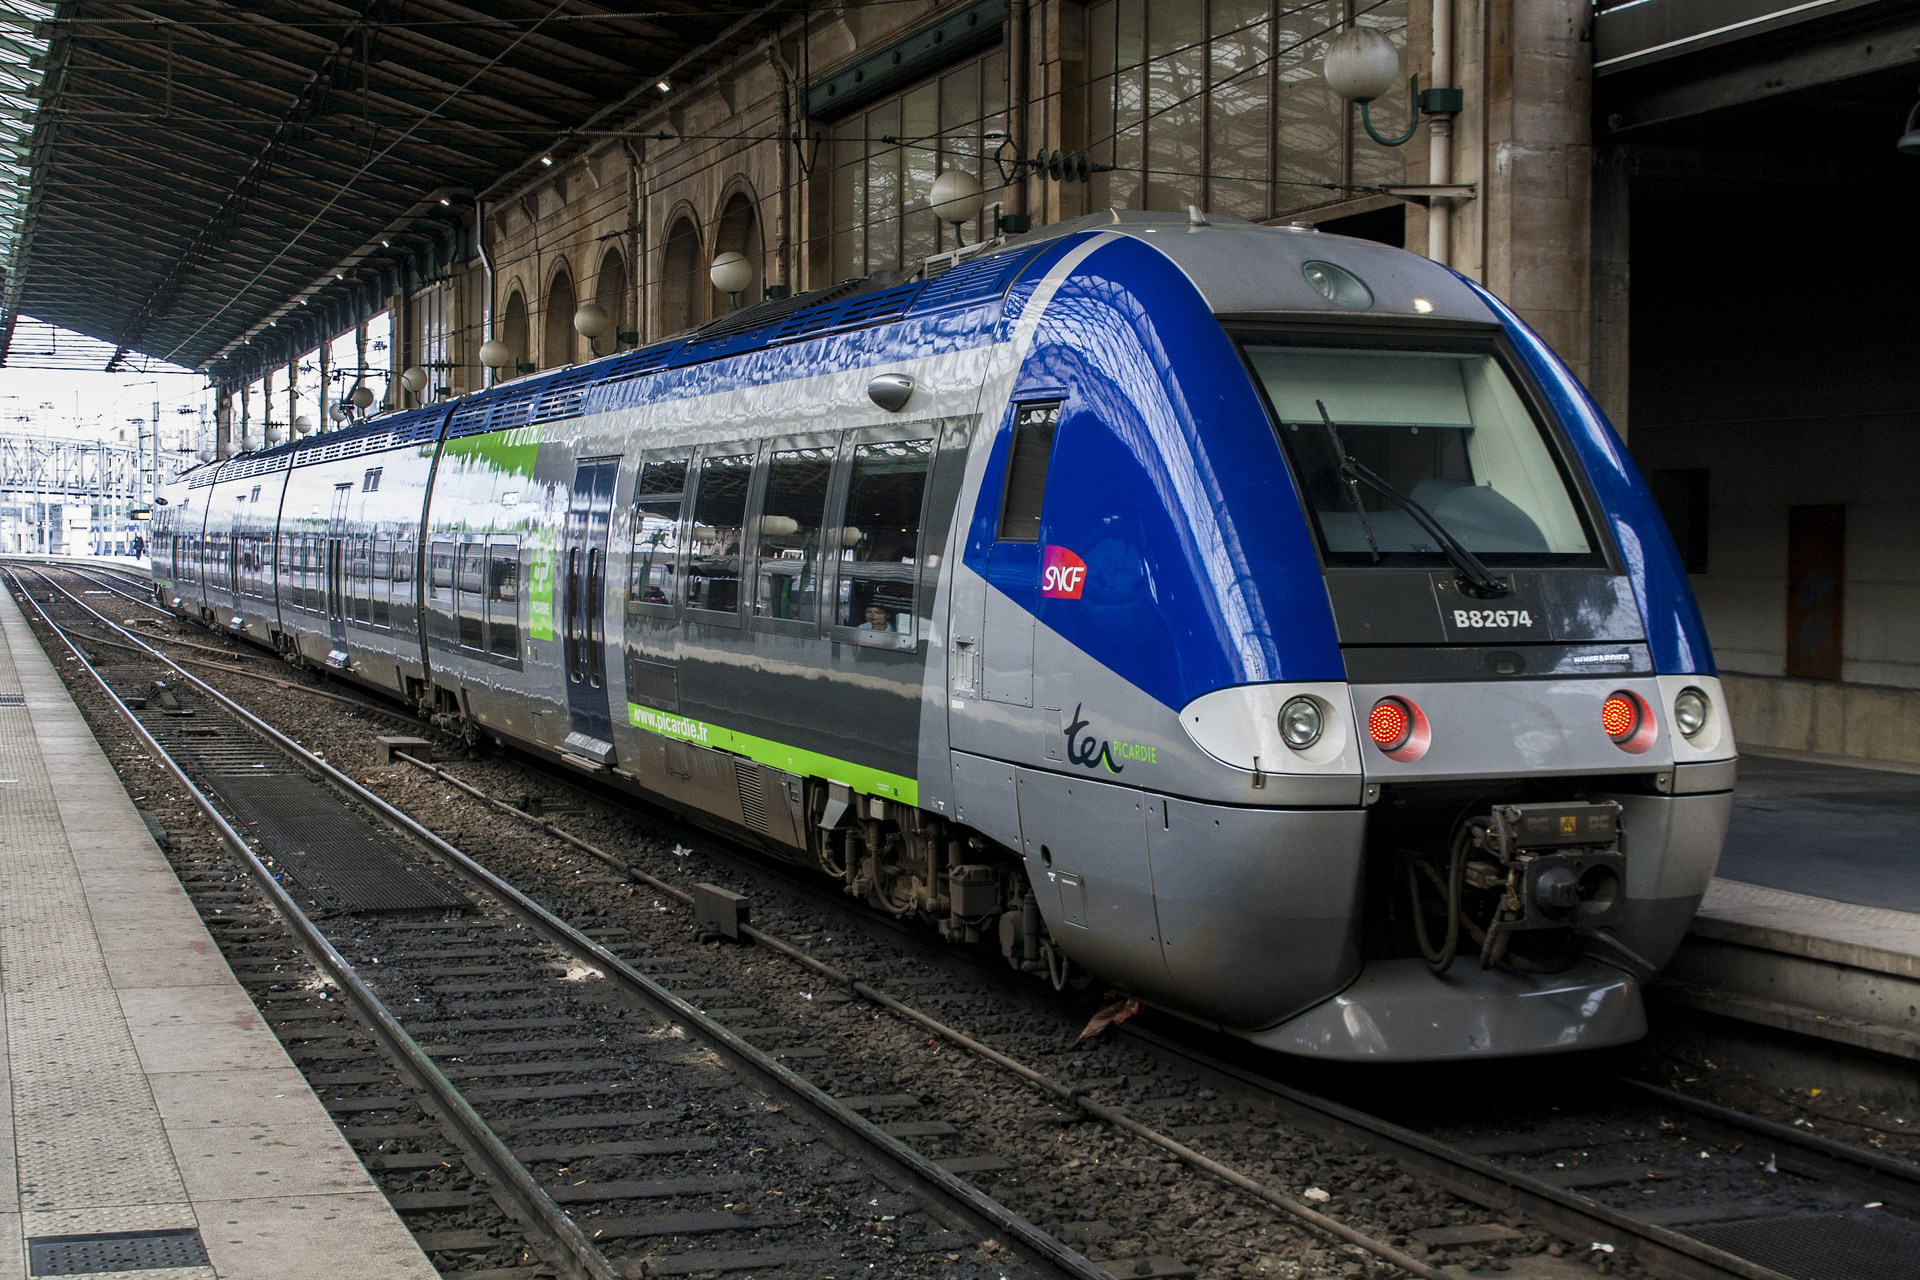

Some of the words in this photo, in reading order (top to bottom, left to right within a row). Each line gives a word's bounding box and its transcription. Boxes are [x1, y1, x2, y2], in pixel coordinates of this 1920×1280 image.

[1042, 566, 1085, 592] SNCF
[1453, 610, 1533, 628] B82674
[633, 708, 708, 742] www.picardie.fr
[1113, 741, 1157, 764] PICARDIE
